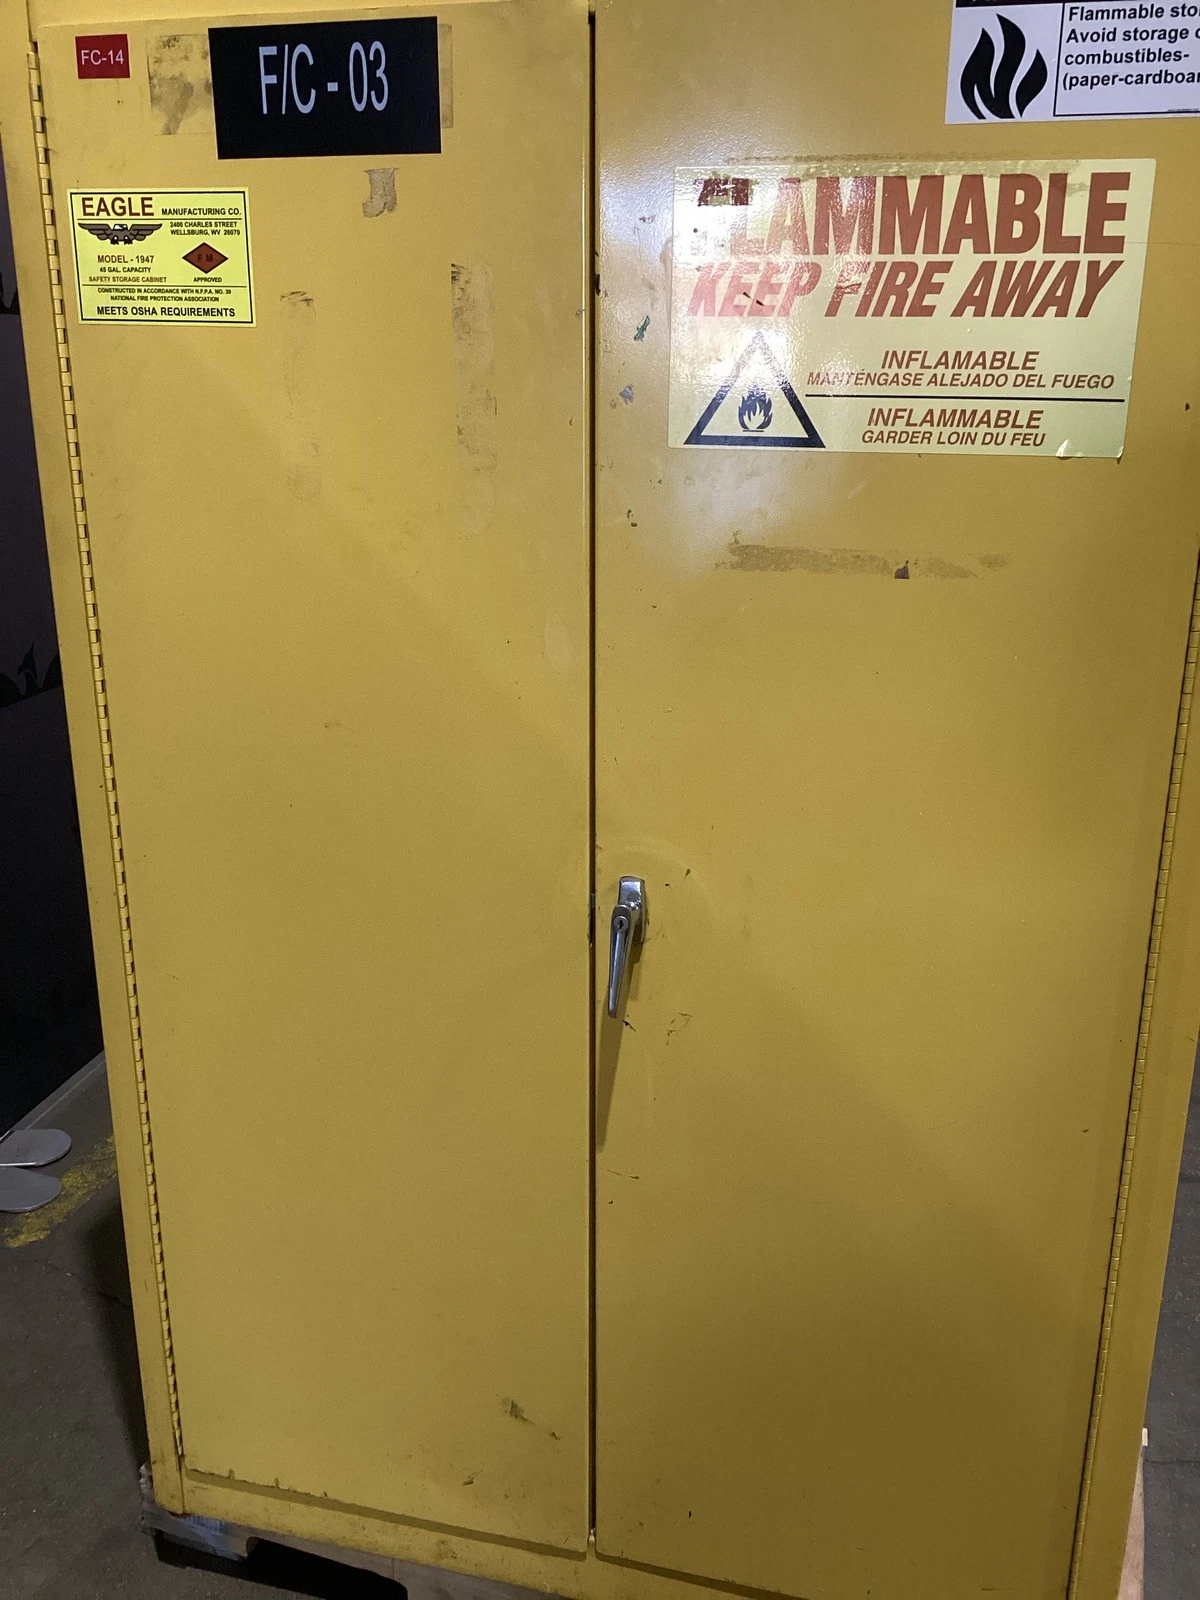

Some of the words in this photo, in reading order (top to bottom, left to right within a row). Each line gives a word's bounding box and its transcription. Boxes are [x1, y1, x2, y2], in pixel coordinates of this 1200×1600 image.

[1068, 4, 1165, 22] Flammable
[1170, 3, 1200, 18] sto
[1066, 27, 1117, 43] Avoid
[1122, 27, 1189, 44] storage
[81, 49, 124, 66] FC-14
[1064, 47, 1190, 66] combustibles-
[258, 43, 316, 115] F/C
[327, 82, 338, 92] -
[349, 41, 389, 112] 03
[81, 196, 155, 217] EAGLE
[161, 207, 226, 216] MANUFACTURING
[228, 207, 242, 216] CO.
[97, 255, 128, 264] MODEL
[135, 255, 154, 264] 1947
[688, 261, 821, 318] KEEP
[824, 261, 953, 318] FIRE
[950, 260, 1125, 318] AWAY
[97, 306, 128, 316] MEETS
[131, 306, 158, 316] OSHA
[160, 307, 236, 317] REQUIREMENTS
[881, 350, 1040, 371] INFLAMABLE
[807, 369, 924, 387] MANTÉNGASE
[927, 372, 1008, 388] ALEJADO
[1012, 373, 1046, 388] DEL
[1051, 374, 1115, 389] FUEGO
[867, 408, 1044, 430] INFLAMMABLE
[862, 430, 933, 445] GARDER
[936, 431, 977, 446] LOIN
[981, 432, 1007, 447] DU
[1010, 432, 1046, 447] FEU
